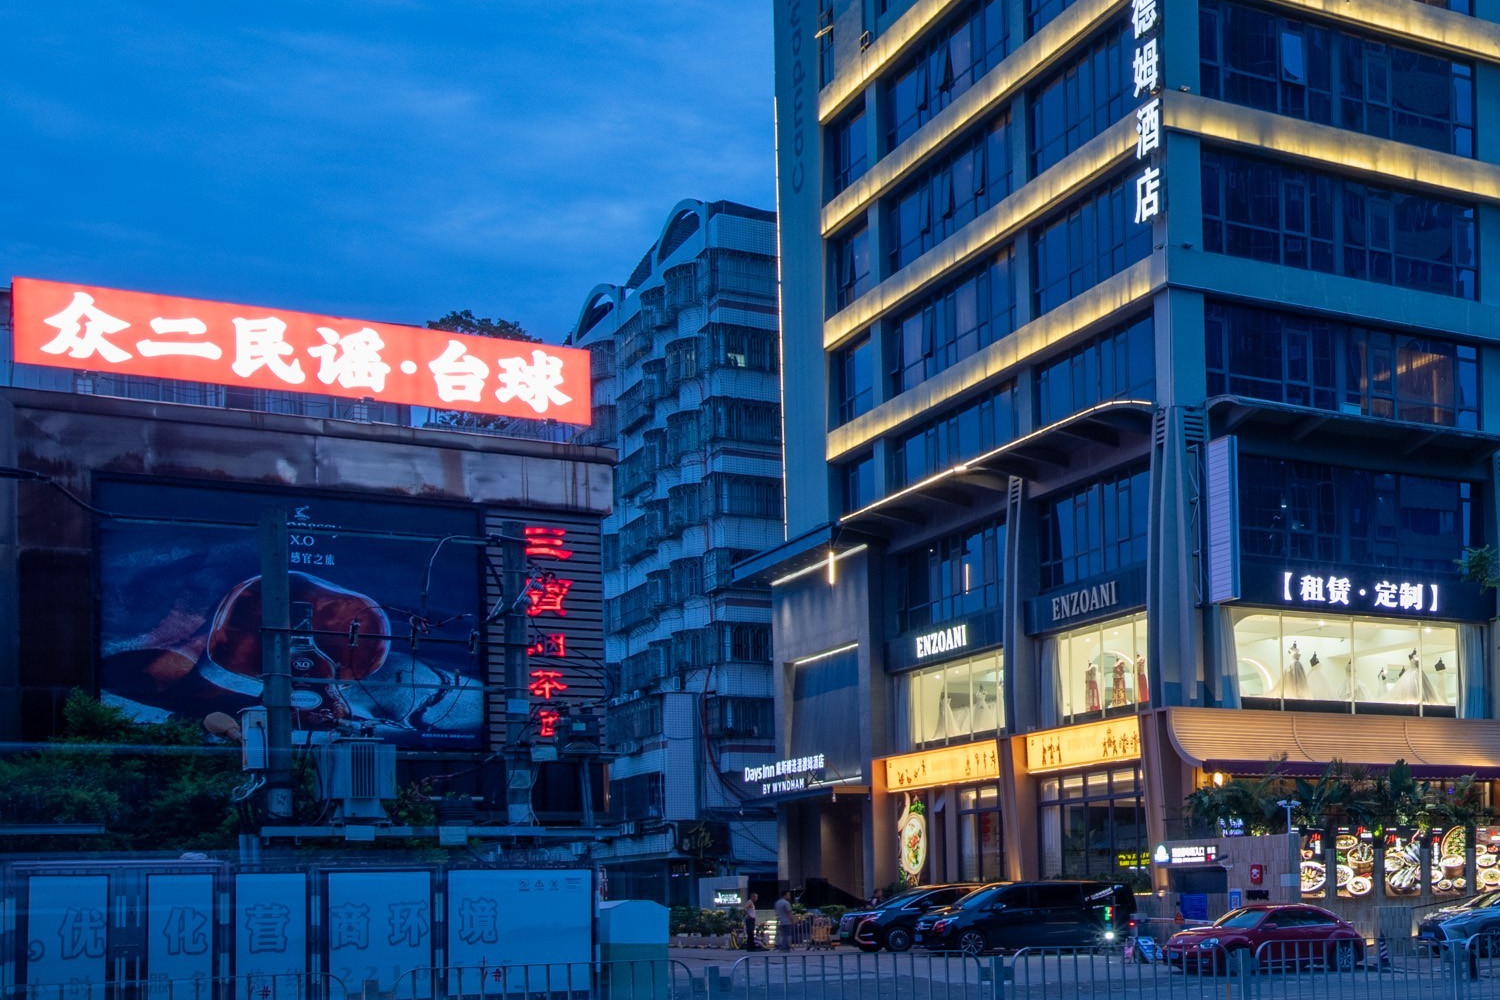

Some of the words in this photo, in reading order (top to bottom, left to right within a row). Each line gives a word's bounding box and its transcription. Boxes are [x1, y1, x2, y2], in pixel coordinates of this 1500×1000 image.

[40, 291, 573, 414] 众二民谣·台球
[1051, 580, 1118, 621] ENZOANI
[916, 624, 967, 658] ENZOANI
[744, 767, 762, 782] Days
[762, 764, 775, 779] Inn
[763, 783, 771, 795] BY
[772, 778, 805, 793] WYNDHAM
